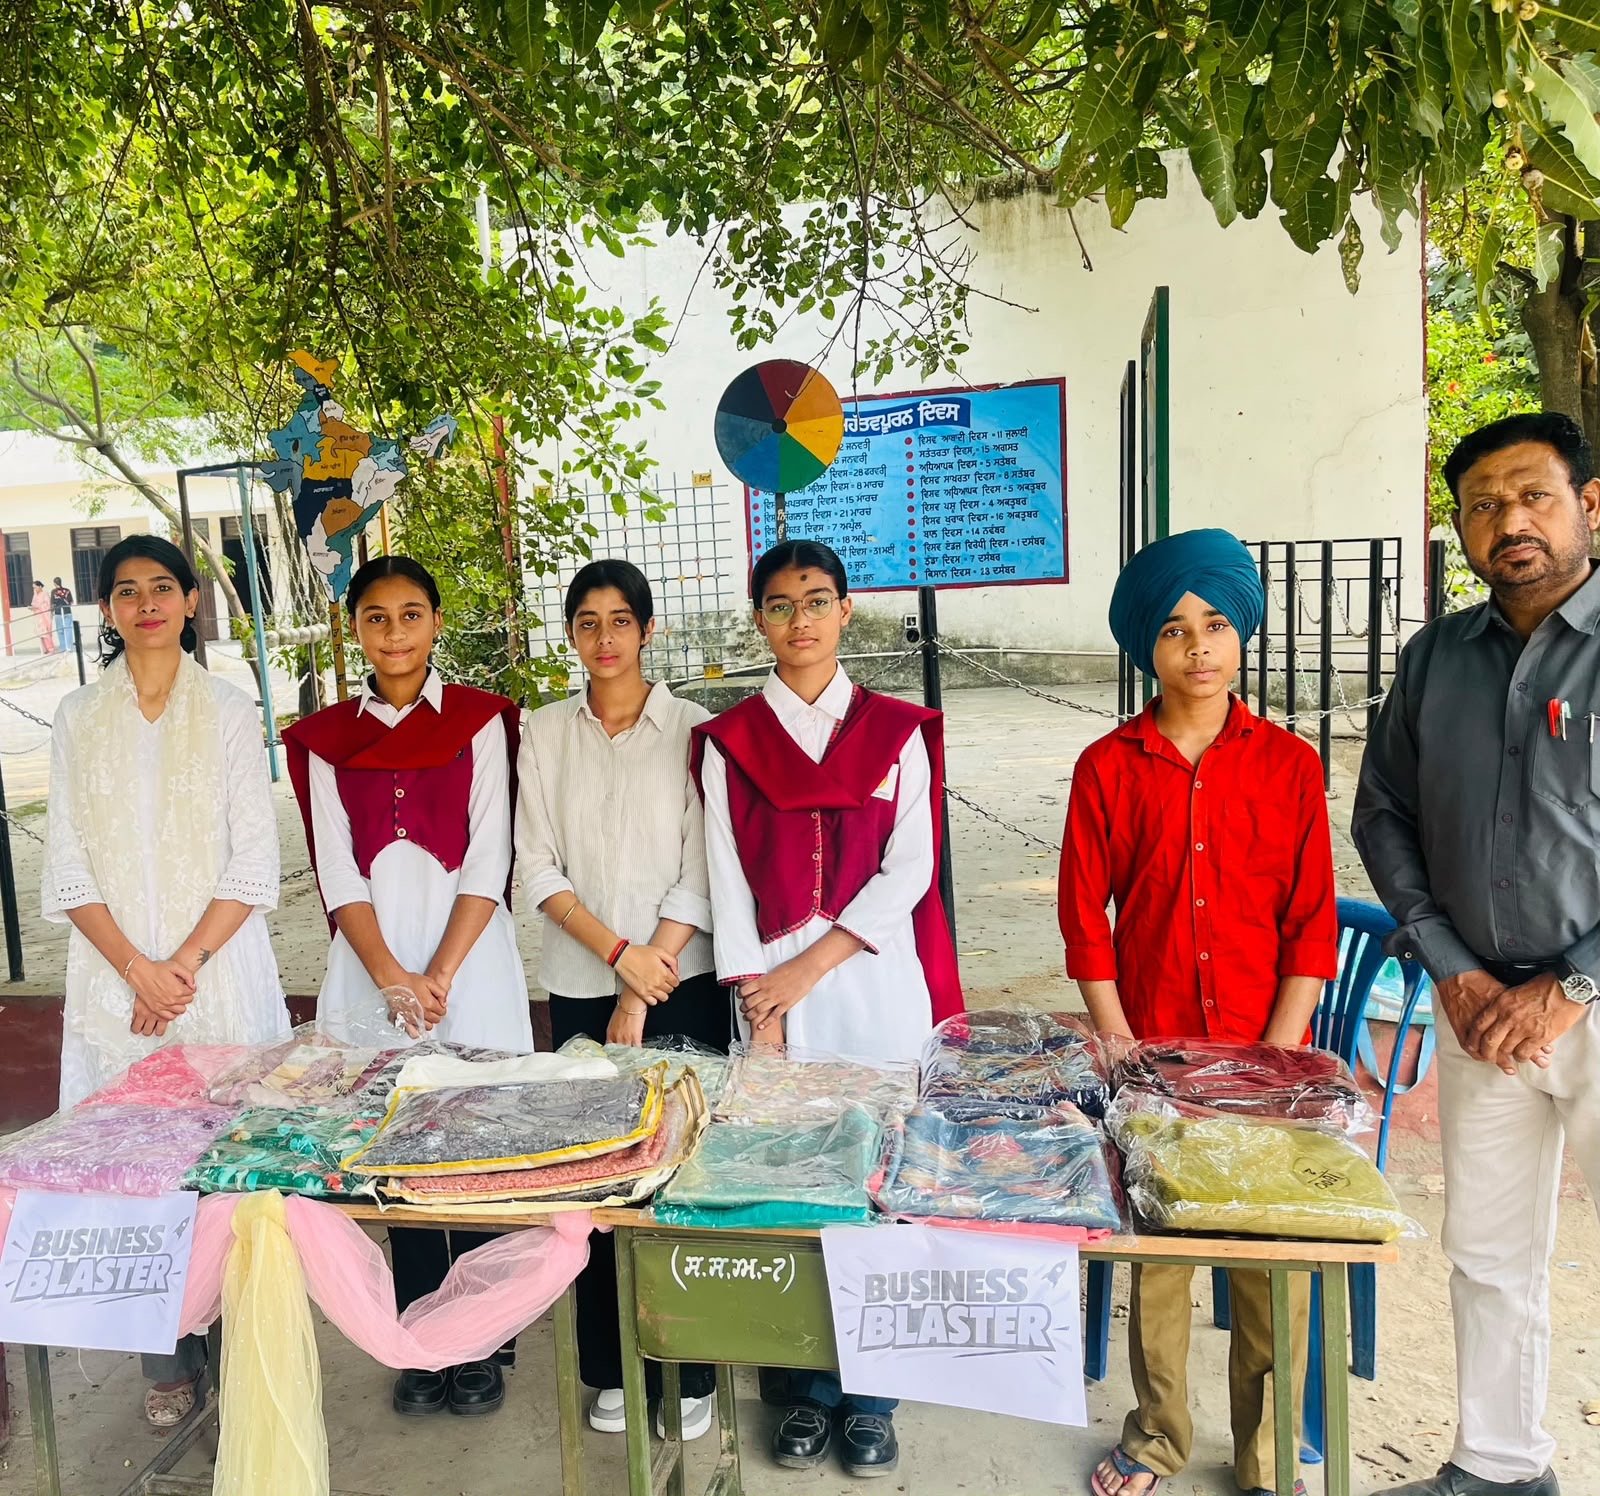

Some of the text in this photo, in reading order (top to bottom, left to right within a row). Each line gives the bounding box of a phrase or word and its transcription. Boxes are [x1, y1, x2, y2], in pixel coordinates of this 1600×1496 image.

[917, 400, 960, 427] ਦਿਵਸ
[969, 430, 988, 442] ਦਿਵਸ
[846, 438, 870, 451] ਜਨਵਰੀ
[982, 445, 990, 453] 15
[841, 452, 867, 464] ਜਨਵਰੀ
[957, 459, 977, 471] ਦਿਵਸ
[830, 467, 848, 481] ਦਿਵਸ
[853, 469, 863, 477] 28
[974, 471, 995, 483] ਦਿਵਸ
[831, 481, 849, 493] ਦਿਵਸ
[864, 480, 884, 489] ਮਾਰਚ
[982, 484, 1001, 496] ਦਿਵਸ
[817, 495, 837, 508] ਦਿਵਸ
[846, 496, 854, 504] 15
[856, 494, 878, 503] ਮਾਰਚ
[960, 499, 979, 512] ਦਿਵਸ
[813, 508, 832, 521] ਦਿਵਸ
[840, 510, 848, 518] 21
[850, 508, 871, 516] ਮਾਰਚ
[968, 512, 988, 525] ਦਿਵਸ
[805, 522, 824, 535] ਦਿਵਸ
[942, 527, 962, 540] ਦਿਵਸ
[843, 536, 851, 544] 18
[990, 538, 1009, 550] ਦਿਵਸ
[942, 554, 960, 567] ਦਿਵਸ
[951, 567, 971, 579] ਦਿਵਸ
[29, 1225, 165, 1258] BUSINESS
[12, 1254, 172, 1302] BLASTER
[864, 1268, 1028, 1304] BUSINESS
[858, 1303, 1056, 1352] BLASTER
